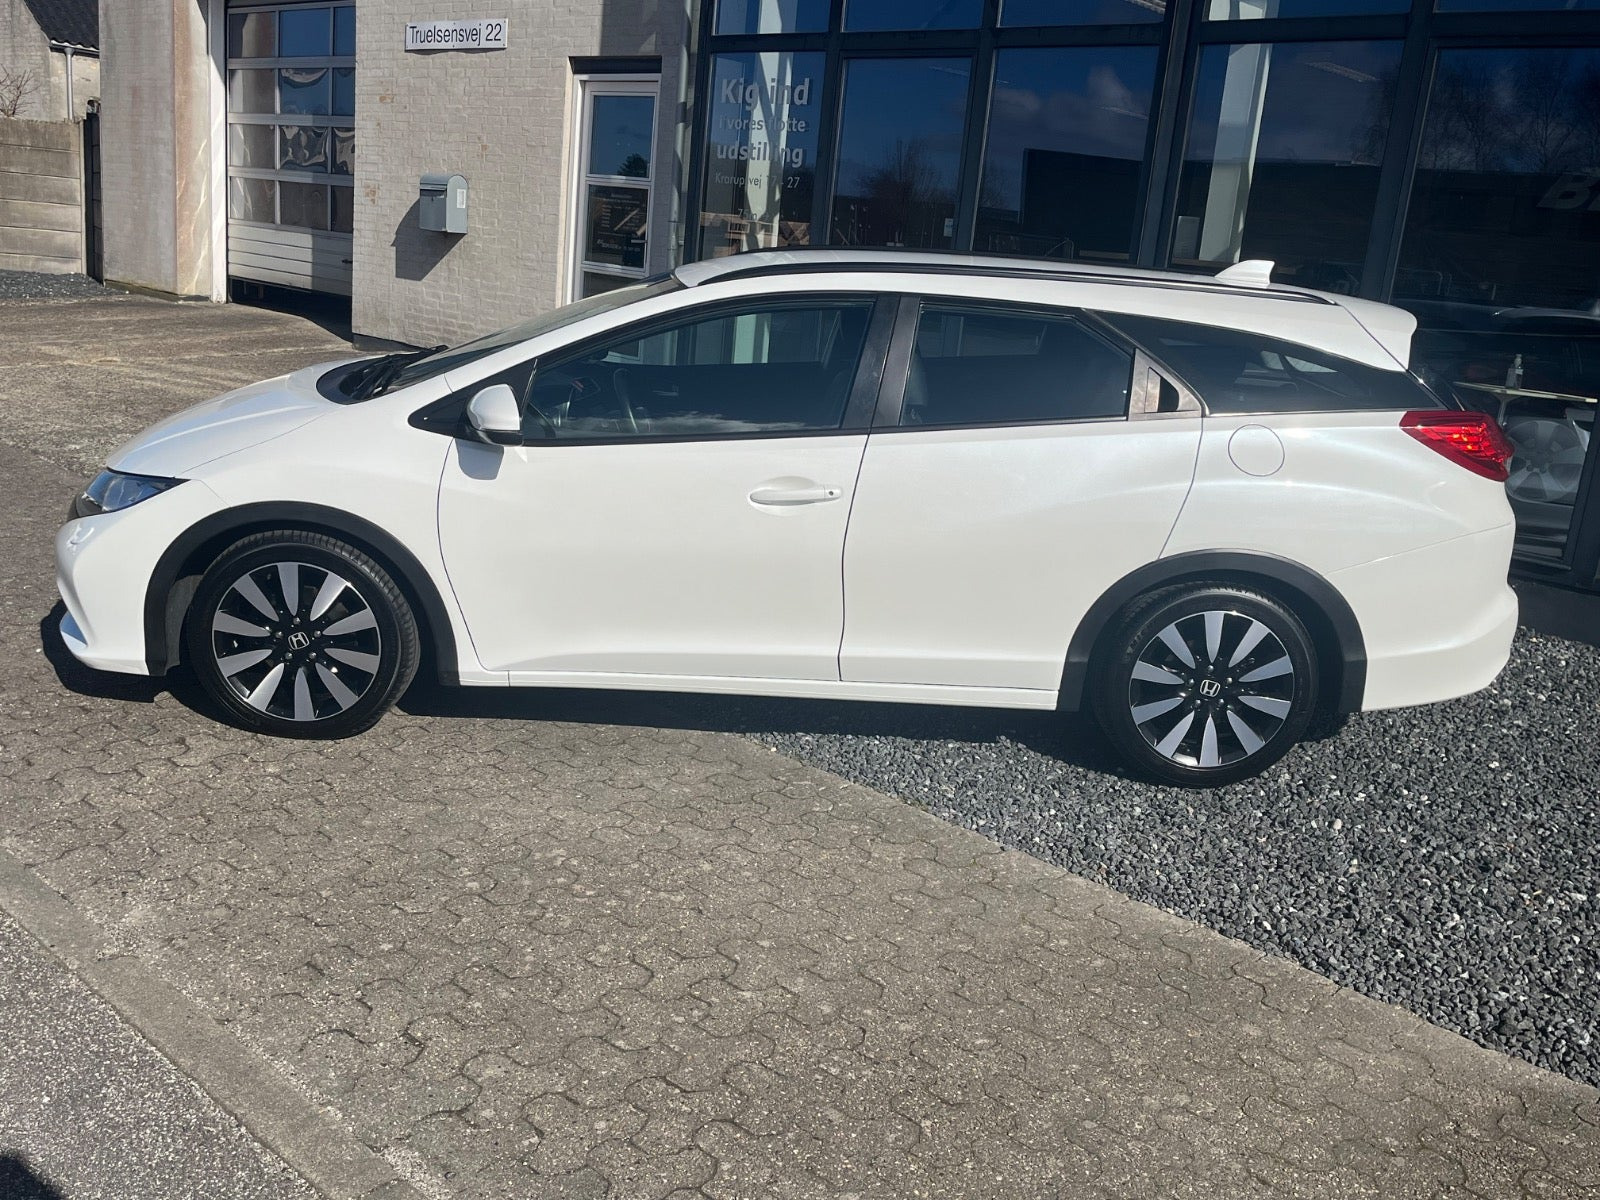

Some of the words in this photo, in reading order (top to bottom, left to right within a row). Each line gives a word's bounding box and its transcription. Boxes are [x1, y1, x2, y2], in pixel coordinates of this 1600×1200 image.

[409, 23, 481, 46] Truelsensvej
[485, 23, 502, 41] 22
[721, 78, 759, 111] Kig
[770, 77, 810, 105] ind
[727, 119, 763, 131] vores
[716, 141, 803, 168] udstilling
[787, 176, 801, 188] 27
